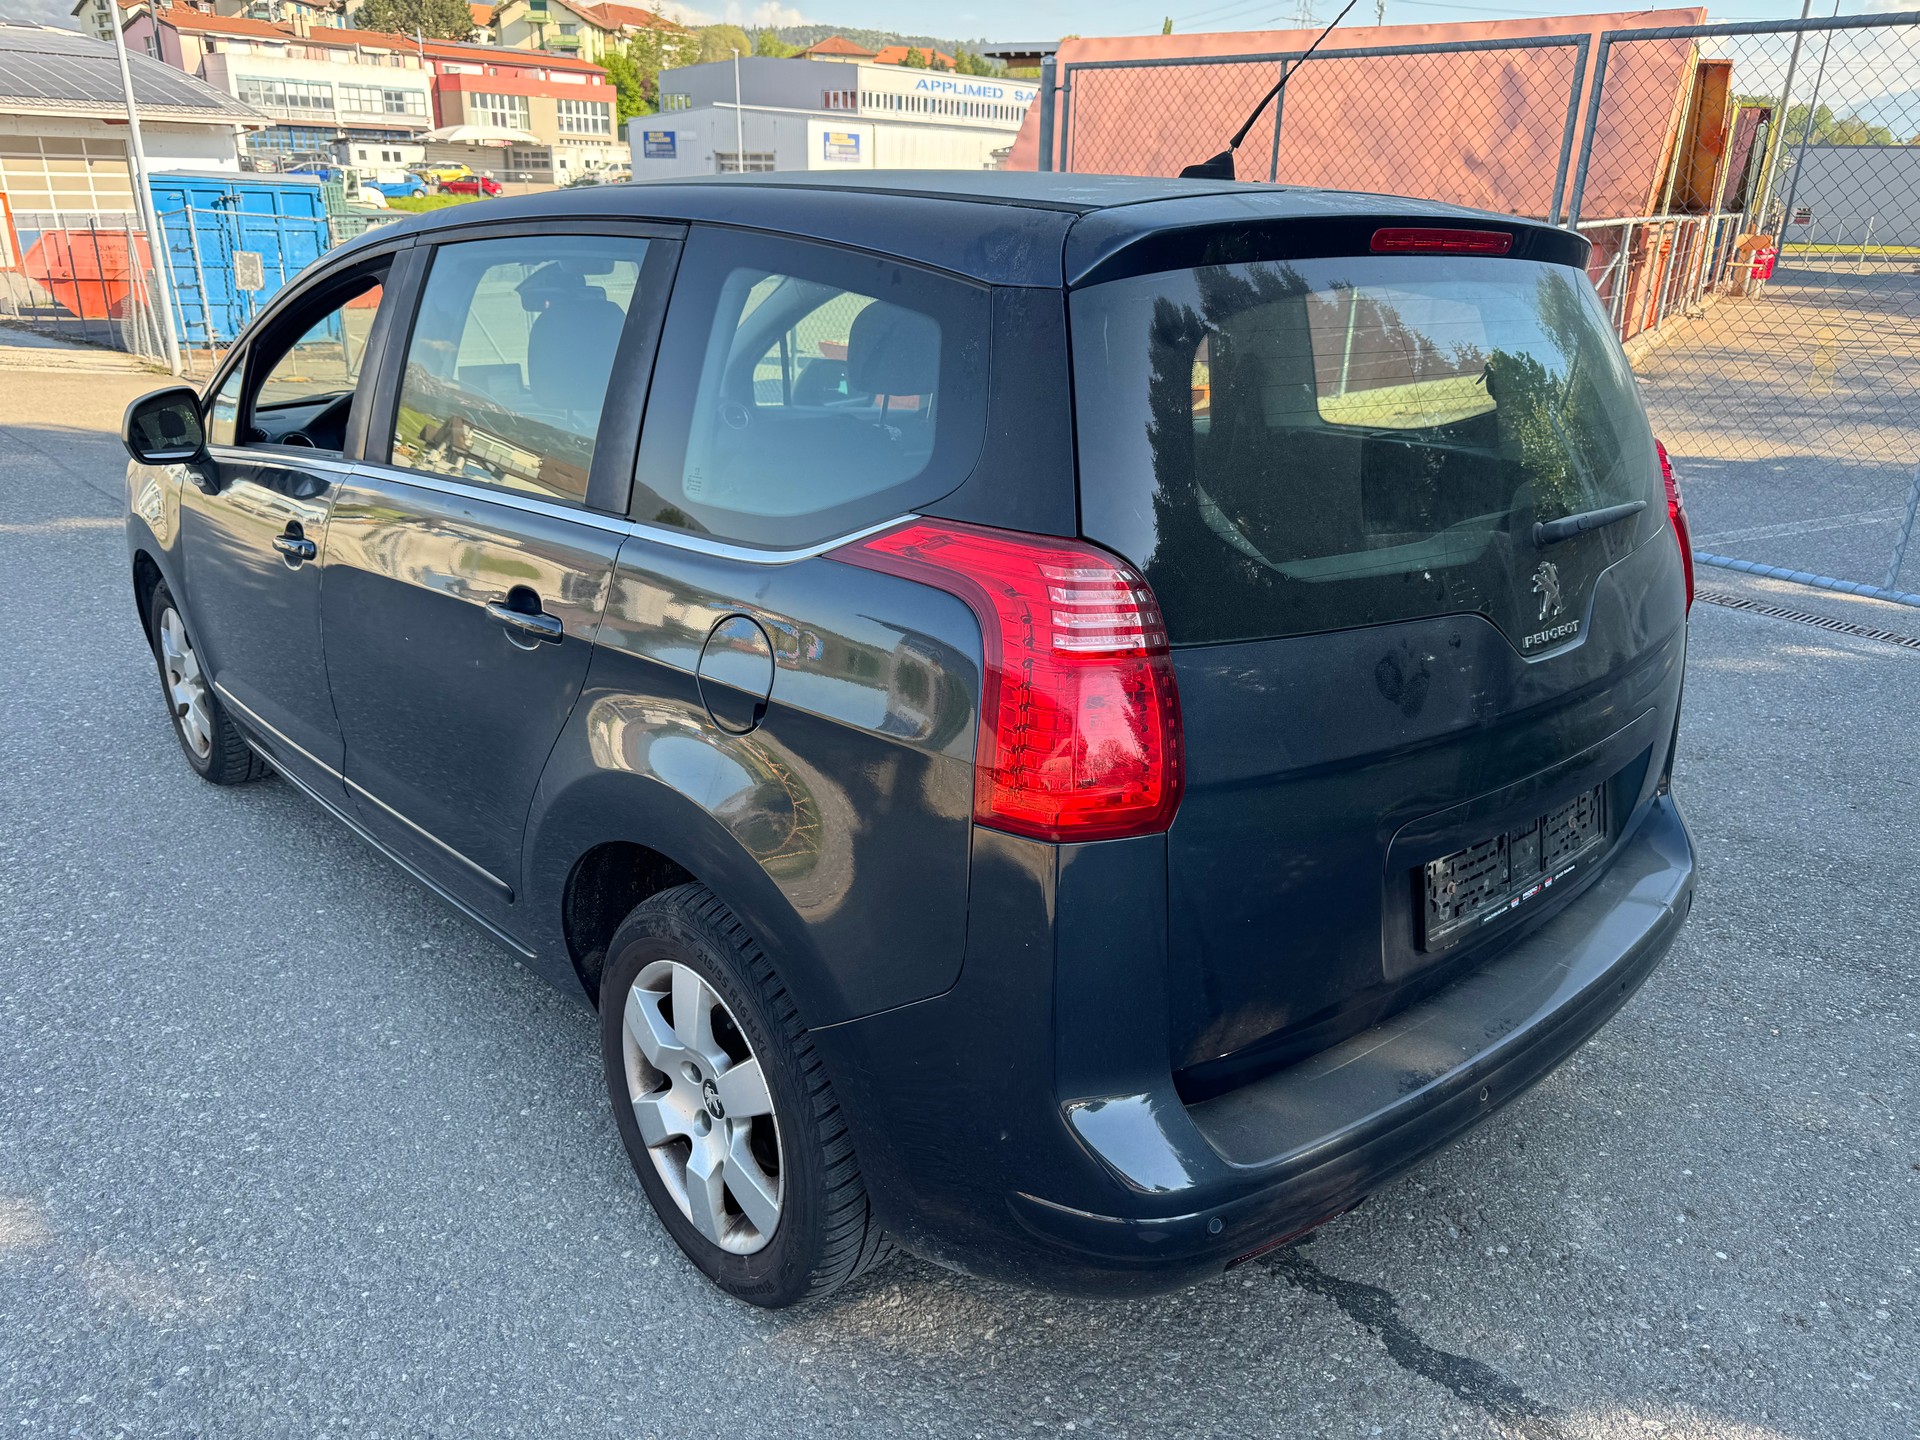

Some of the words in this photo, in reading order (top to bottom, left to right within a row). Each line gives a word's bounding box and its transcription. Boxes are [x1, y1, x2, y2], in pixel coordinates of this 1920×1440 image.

[915, 79, 1004, 99] APPLIMED
[1014, 90, 1036, 101] SA
[1522, 619, 1580, 648] PEUGEOT
[696, 948, 730, 989] 215/55
